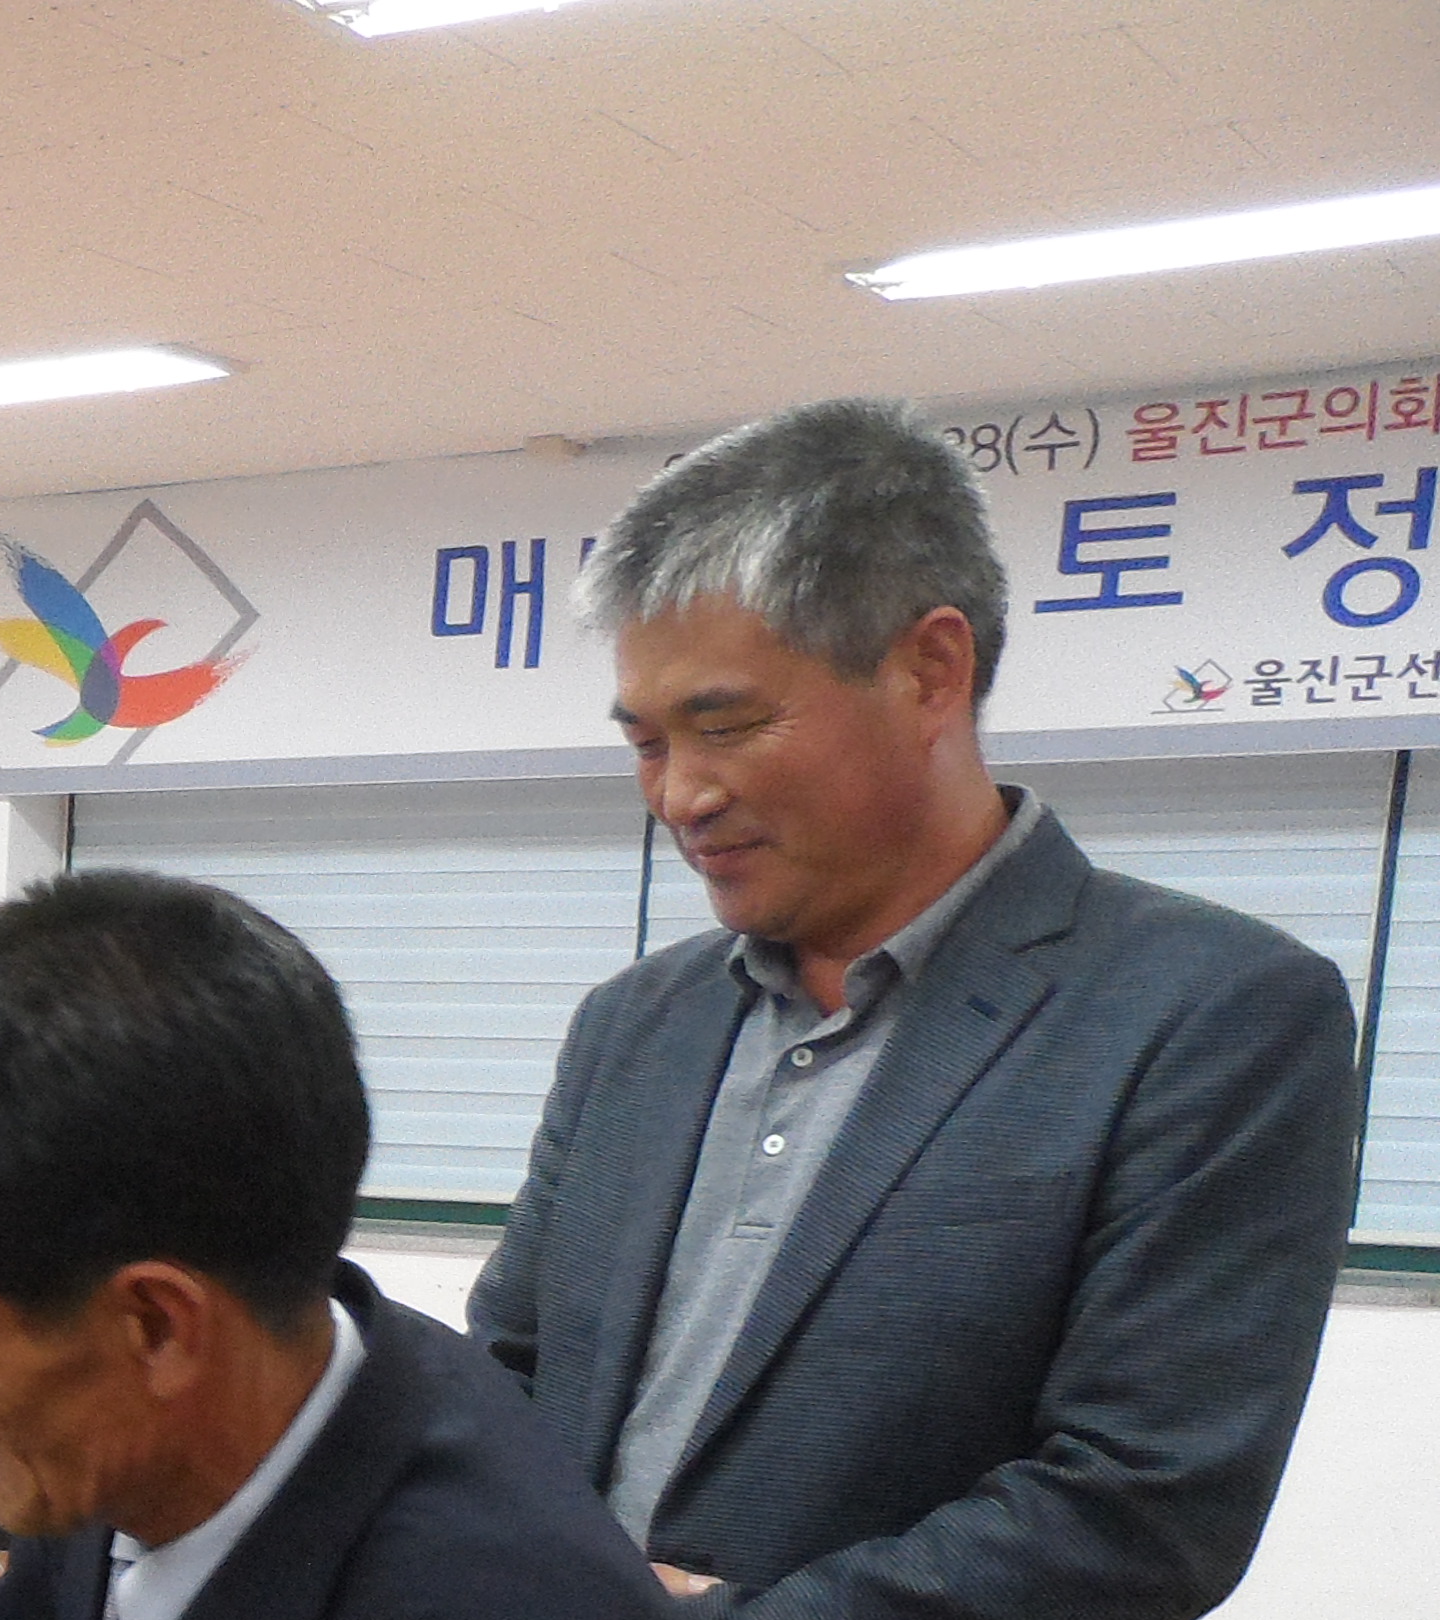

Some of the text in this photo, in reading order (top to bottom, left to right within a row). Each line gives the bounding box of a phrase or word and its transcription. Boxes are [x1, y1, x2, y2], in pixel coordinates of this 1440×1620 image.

[1125, 373, 1440, 462] 울진군의회
[1281, 467, 1439, 628] 정
[1244, 650, 1440, 706] 울진군선
